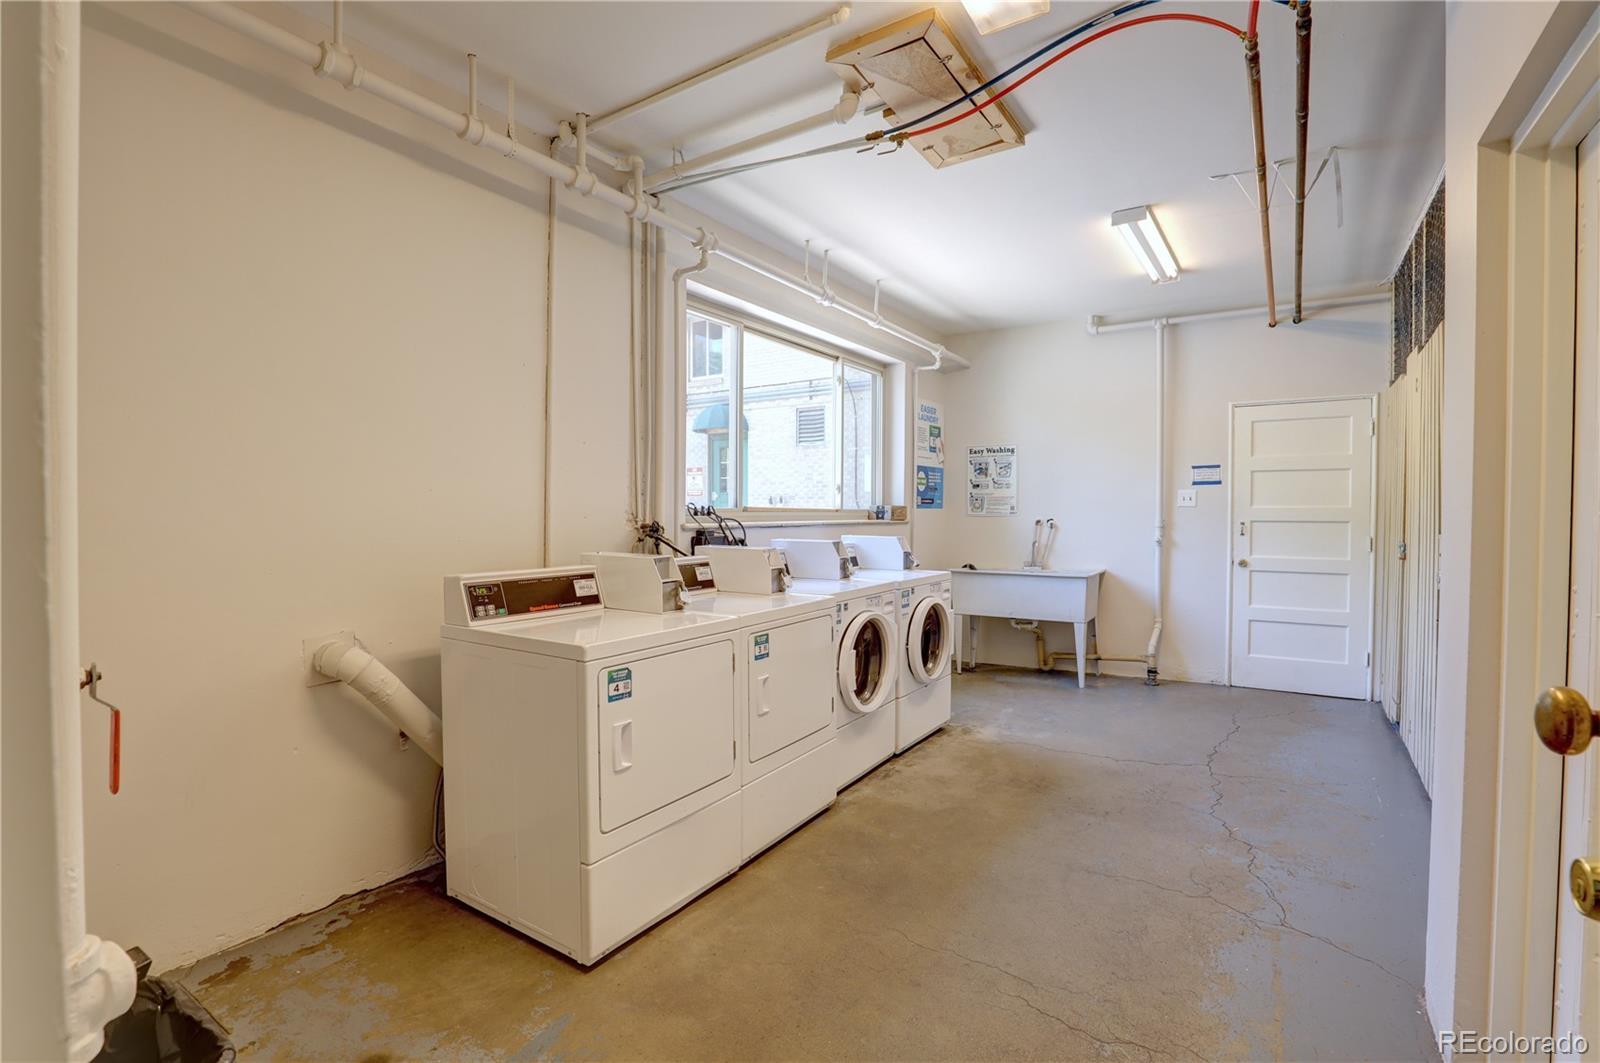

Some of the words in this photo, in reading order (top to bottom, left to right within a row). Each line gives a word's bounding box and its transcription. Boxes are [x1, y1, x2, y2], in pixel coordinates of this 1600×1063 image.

[920, 404, 937, 415] EASIER
[918, 412, 939, 424] LAUNDRY
[969, 448, 984, 456] Easy
[986, 446, 1016, 455] Washing
[613, 683, 620, 693] 4
